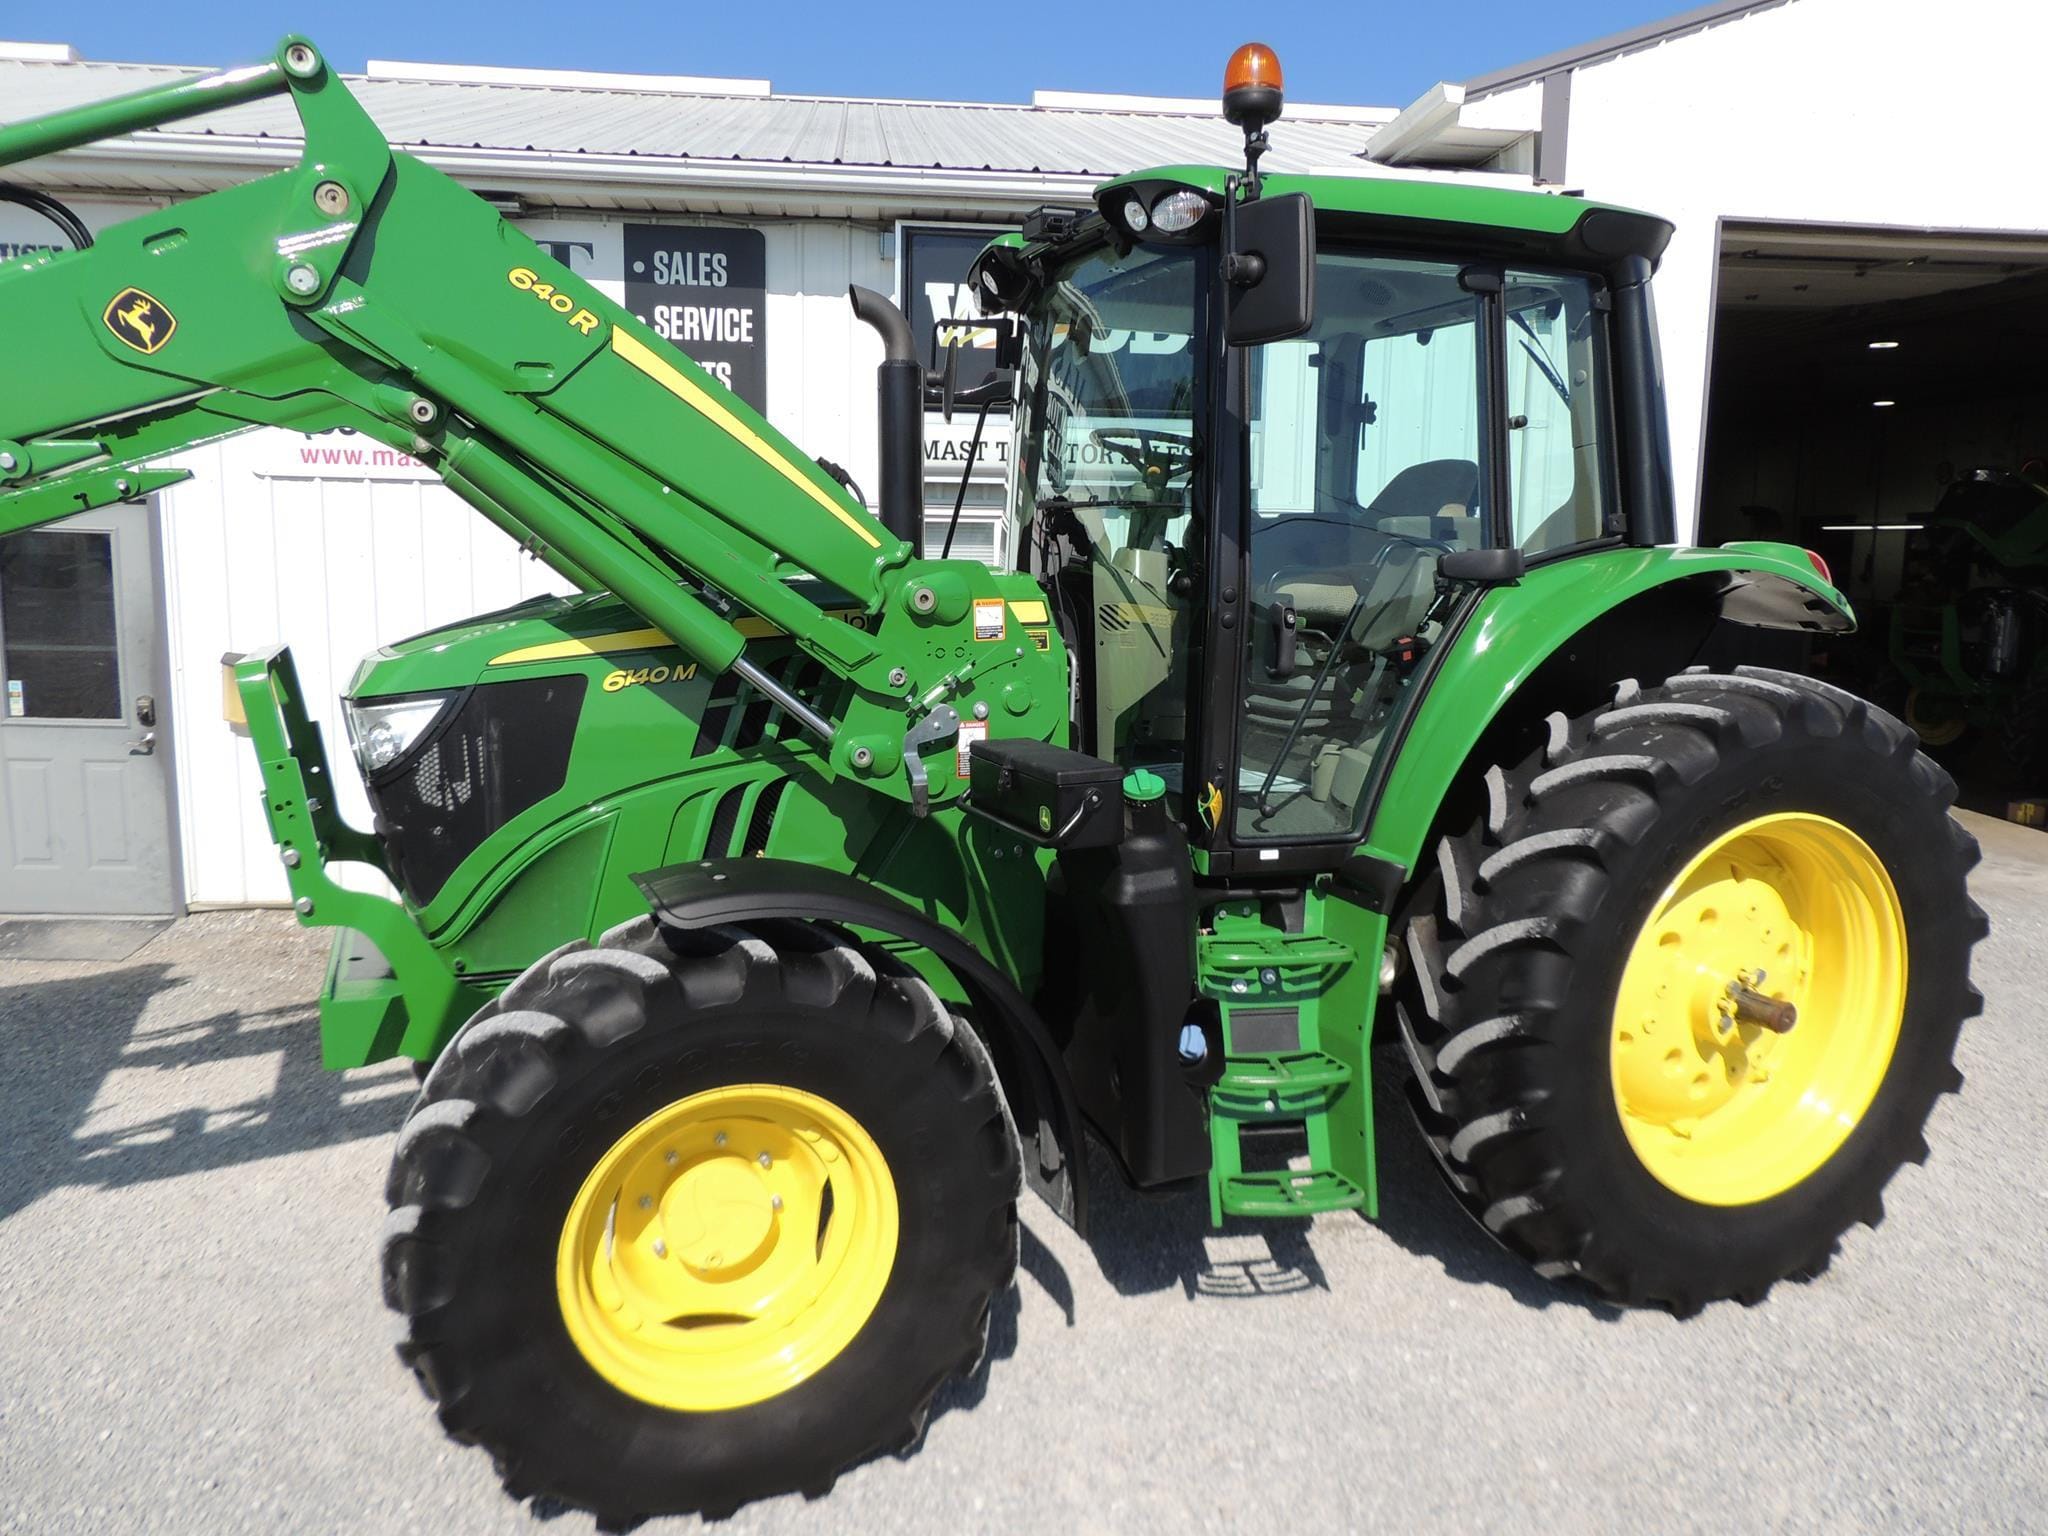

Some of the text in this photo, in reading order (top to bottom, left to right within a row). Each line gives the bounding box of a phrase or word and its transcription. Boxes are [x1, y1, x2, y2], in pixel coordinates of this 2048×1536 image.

[653, 250, 728, 287] SALES
[654, 305, 754, 342] SERVICE
[923, 440, 988, 461] MAST
